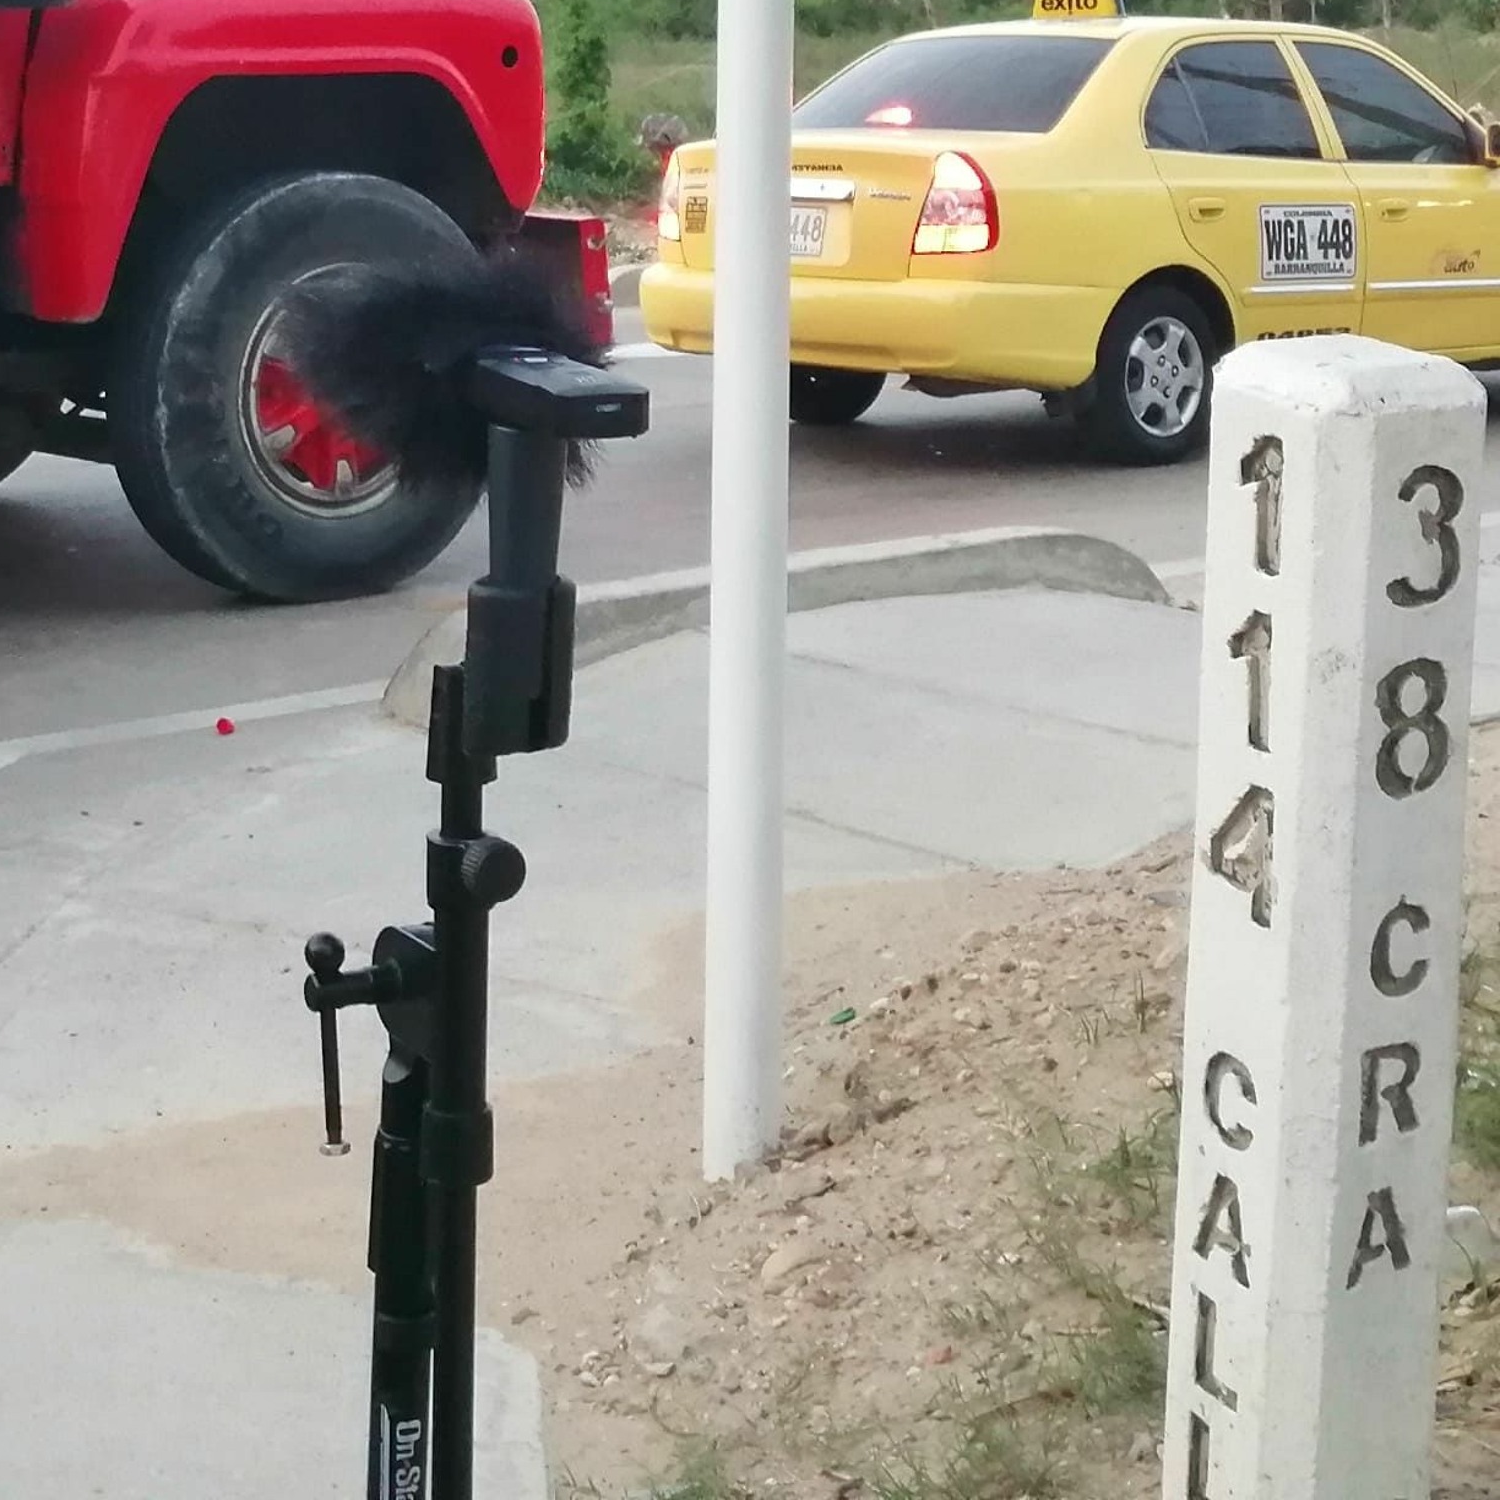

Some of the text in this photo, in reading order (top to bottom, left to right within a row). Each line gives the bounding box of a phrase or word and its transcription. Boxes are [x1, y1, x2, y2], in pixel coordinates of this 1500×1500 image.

[1263, 218, 1354, 261] WGA 448
[1273, 261, 1345, 275] BARRANQUILLA
[1204, 433, 1285, 929] 114
[1345, 464, 1464, 1291] 38 CRA
